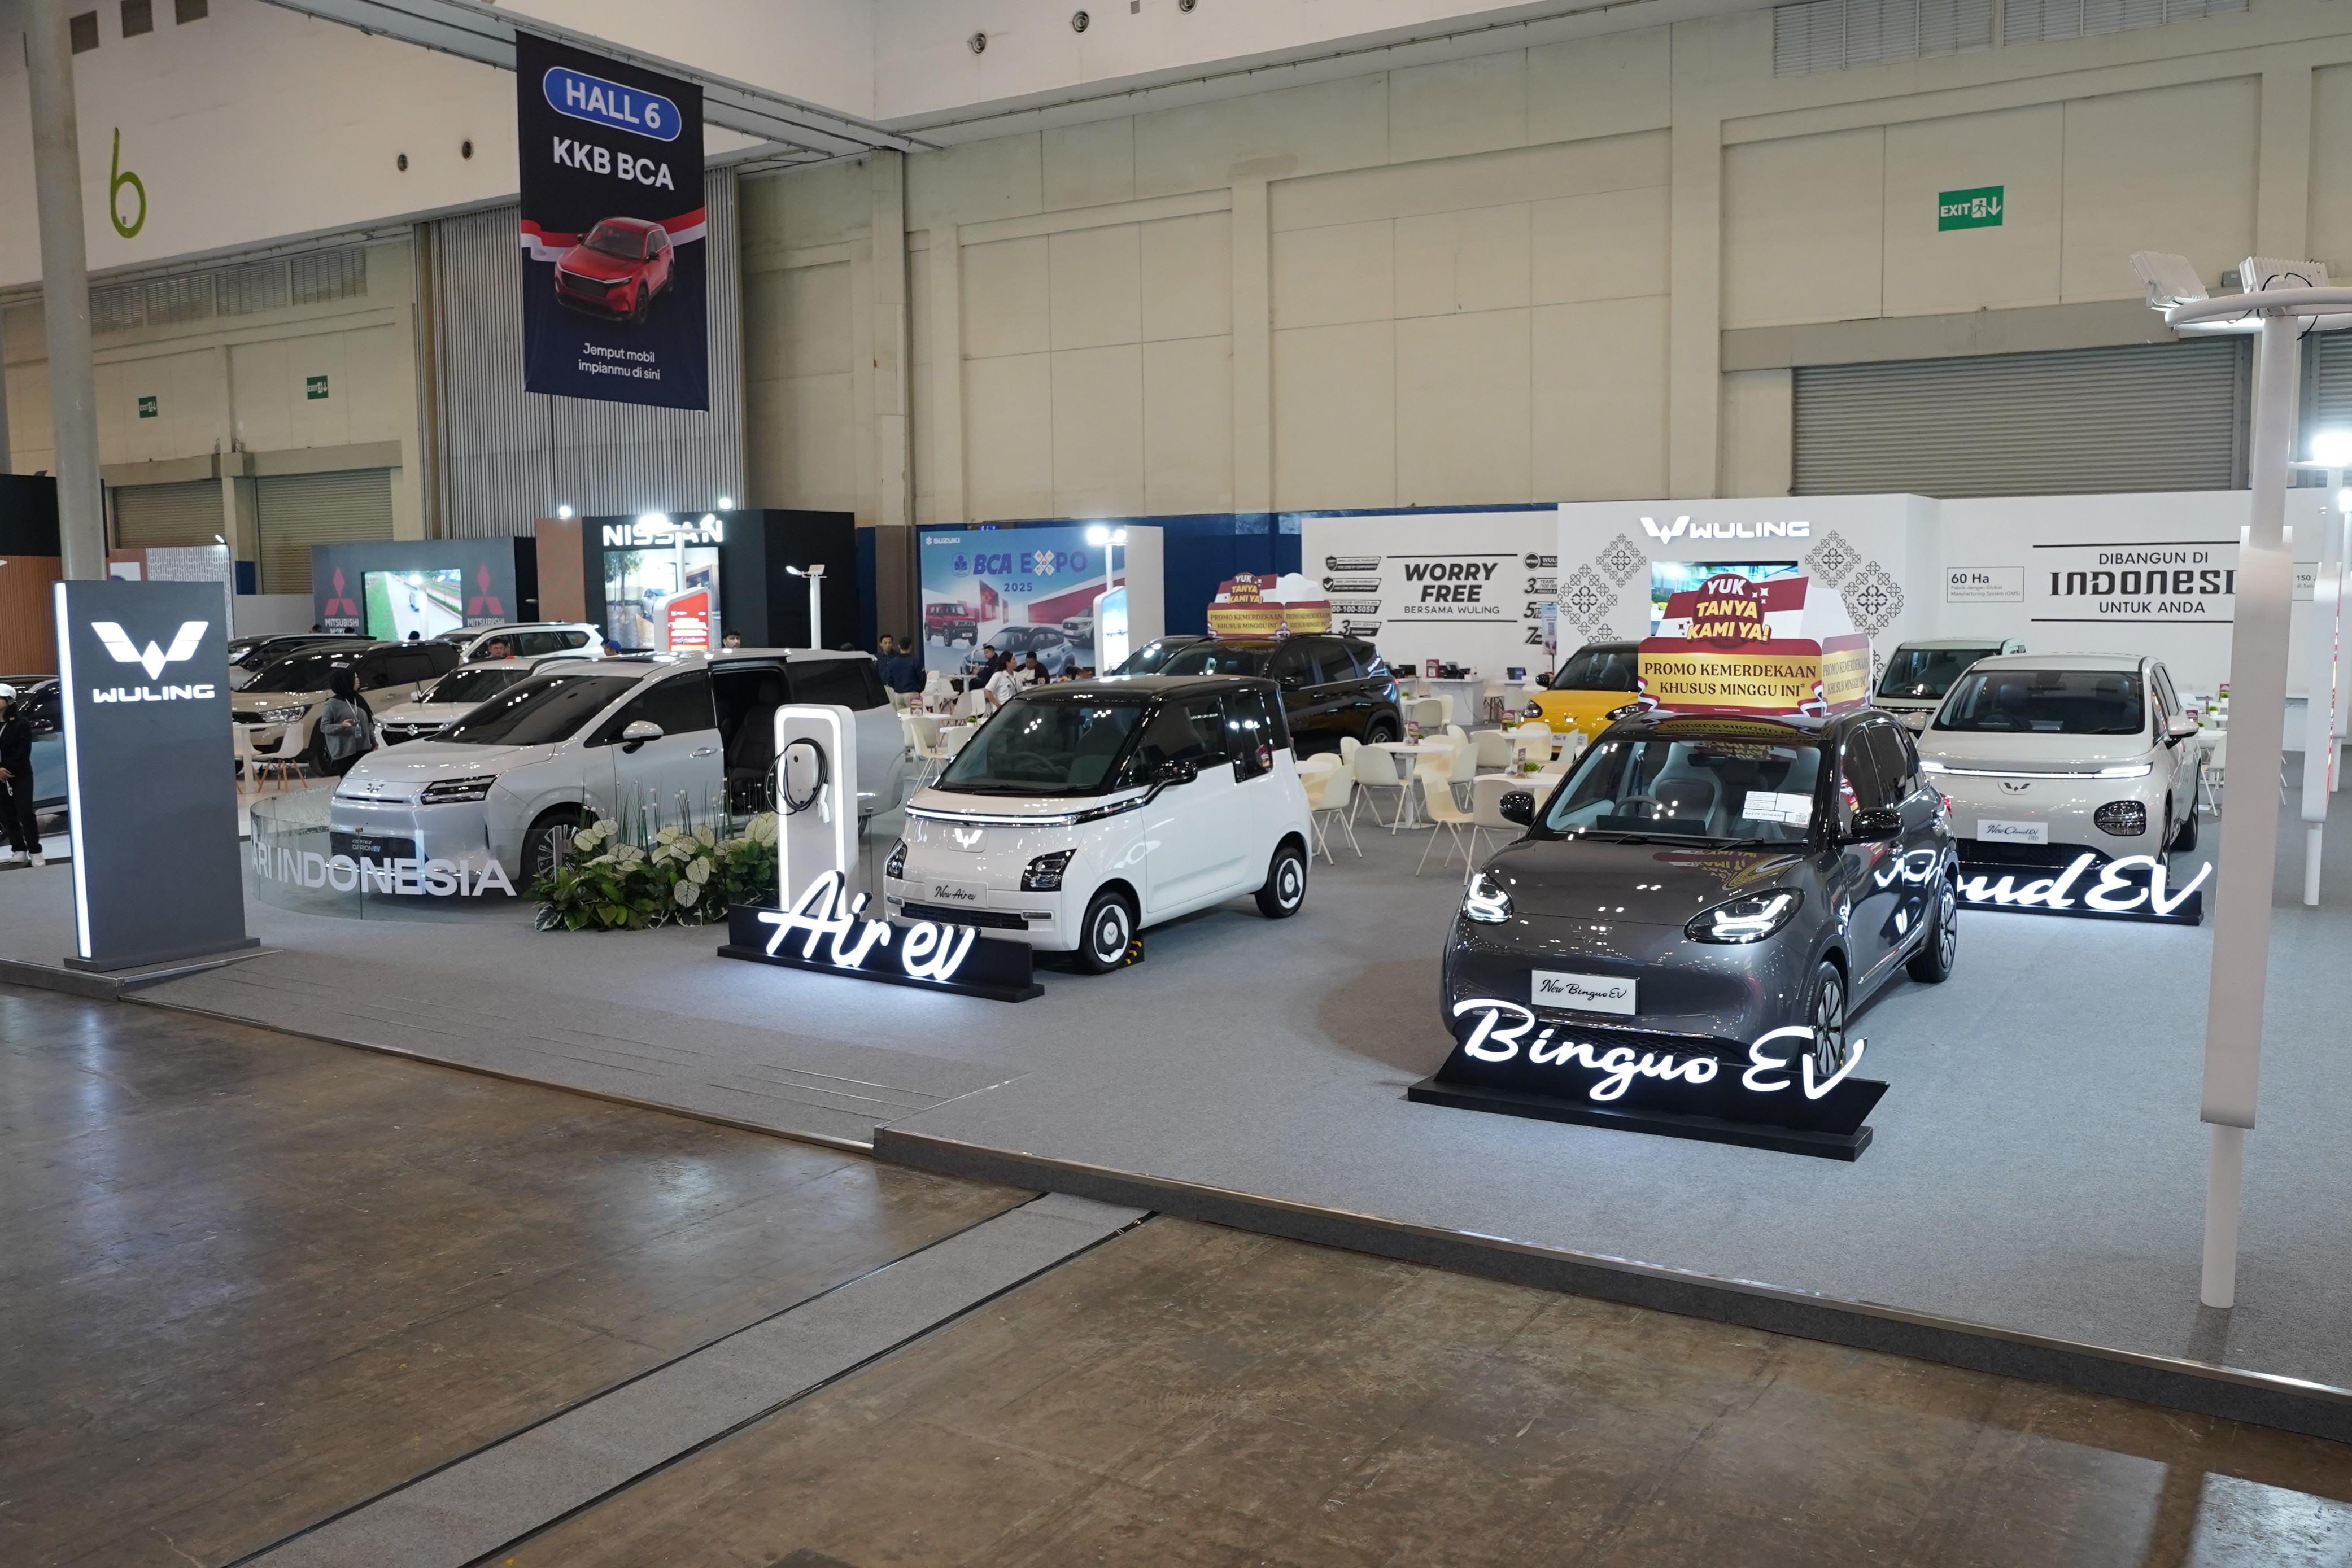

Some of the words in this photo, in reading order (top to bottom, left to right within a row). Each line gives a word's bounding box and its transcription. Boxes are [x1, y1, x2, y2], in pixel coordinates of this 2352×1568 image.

[566, 78, 639, 124] HALL
[644, 103, 661, 129] 6
[553, 136, 611, 174] KKB
[618, 152, 674, 191] BCA
[110, 127, 146, 238] 6
[1941, 203, 1971, 217] EXIT
[583, 343, 625, 360] Jemput
[627, 351, 655, 363] mobil
[578, 359, 630, 375] impianmu
[632, 367, 642, 378] di
[644, 368, 660, 380] sini
[1690, 521, 1810, 539] WULING
[973, 553, 1012, 575] BCA
[1021, 549, 1087, 576] EXPO
[2100, 552, 2186, 564] DIBANGUN
[2193, 552, 2208, 563] DI
[1236, 575, 1252, 583] YUK
[1404, 562, 1499, 582] WORRY
[1951, 573, 1967, 583] 60
[1973, 573, 1989, 583] Ha
[1004, 583, 1033, 592] 2025
[1232, 585, 1258, 593] TANYA
[1524, 578, 1537, 594] 3
[1707, 578, 1746, 596] YUK
[2049, 570, 2237, 596] INDONESI
[1228, 595, 1249, 604] KAMI
[1249, 595, 1263, 604] YA!
[1420, 584, 1482, 602] FREE
[1524, 602, 1537, 618] 5
[1696, 600, 1758, 619] TANYA
[2100, 602, 2152, 613] UNTUK
[2158, 601, 2205, 613] ANDA
[325, 618, 359, 627] MITSUBISHI
[468, 618, 505, 627] MITSUBISHI
[1339, 620, 1351, 634] 3
[1687, 622, 1735, 640] KAMI
[1738, 622, 1771, 641] YA!
[1644, 662, 1696, 676] PROMO
[1700, 663, 1816, 678] KEMERDEKAAN
[1823, 662, 1839, 677] PROMO
[94, 684, 215, 703] WULING
[1660, 682, 1716, 695] KHUSUS
[1720, 684, 1777, 696] MINGGU
[1827, 680, 1844, 695] KHUSUS
[1986, 824, 2004, 833] New
[2004, 826, 2030, 835] Cloud
[277, 846, 517, 897] INDONESIA
[935, 885, 952, 898] New
[952, 889, 968, 899] Air
[2085, 855, 2212, 914] EV
[758, 870, 891, 967] Air
[902, 921, 977, 980] ev
[1540, 979, 1564, 993] New
[1566, 984, 1608, 1001] Binguo
[1609, 988, 1627, 998] EV
[1452, 999, 1718, 1102] Binguo
[1742, 1025, 1866, 1100] EV
